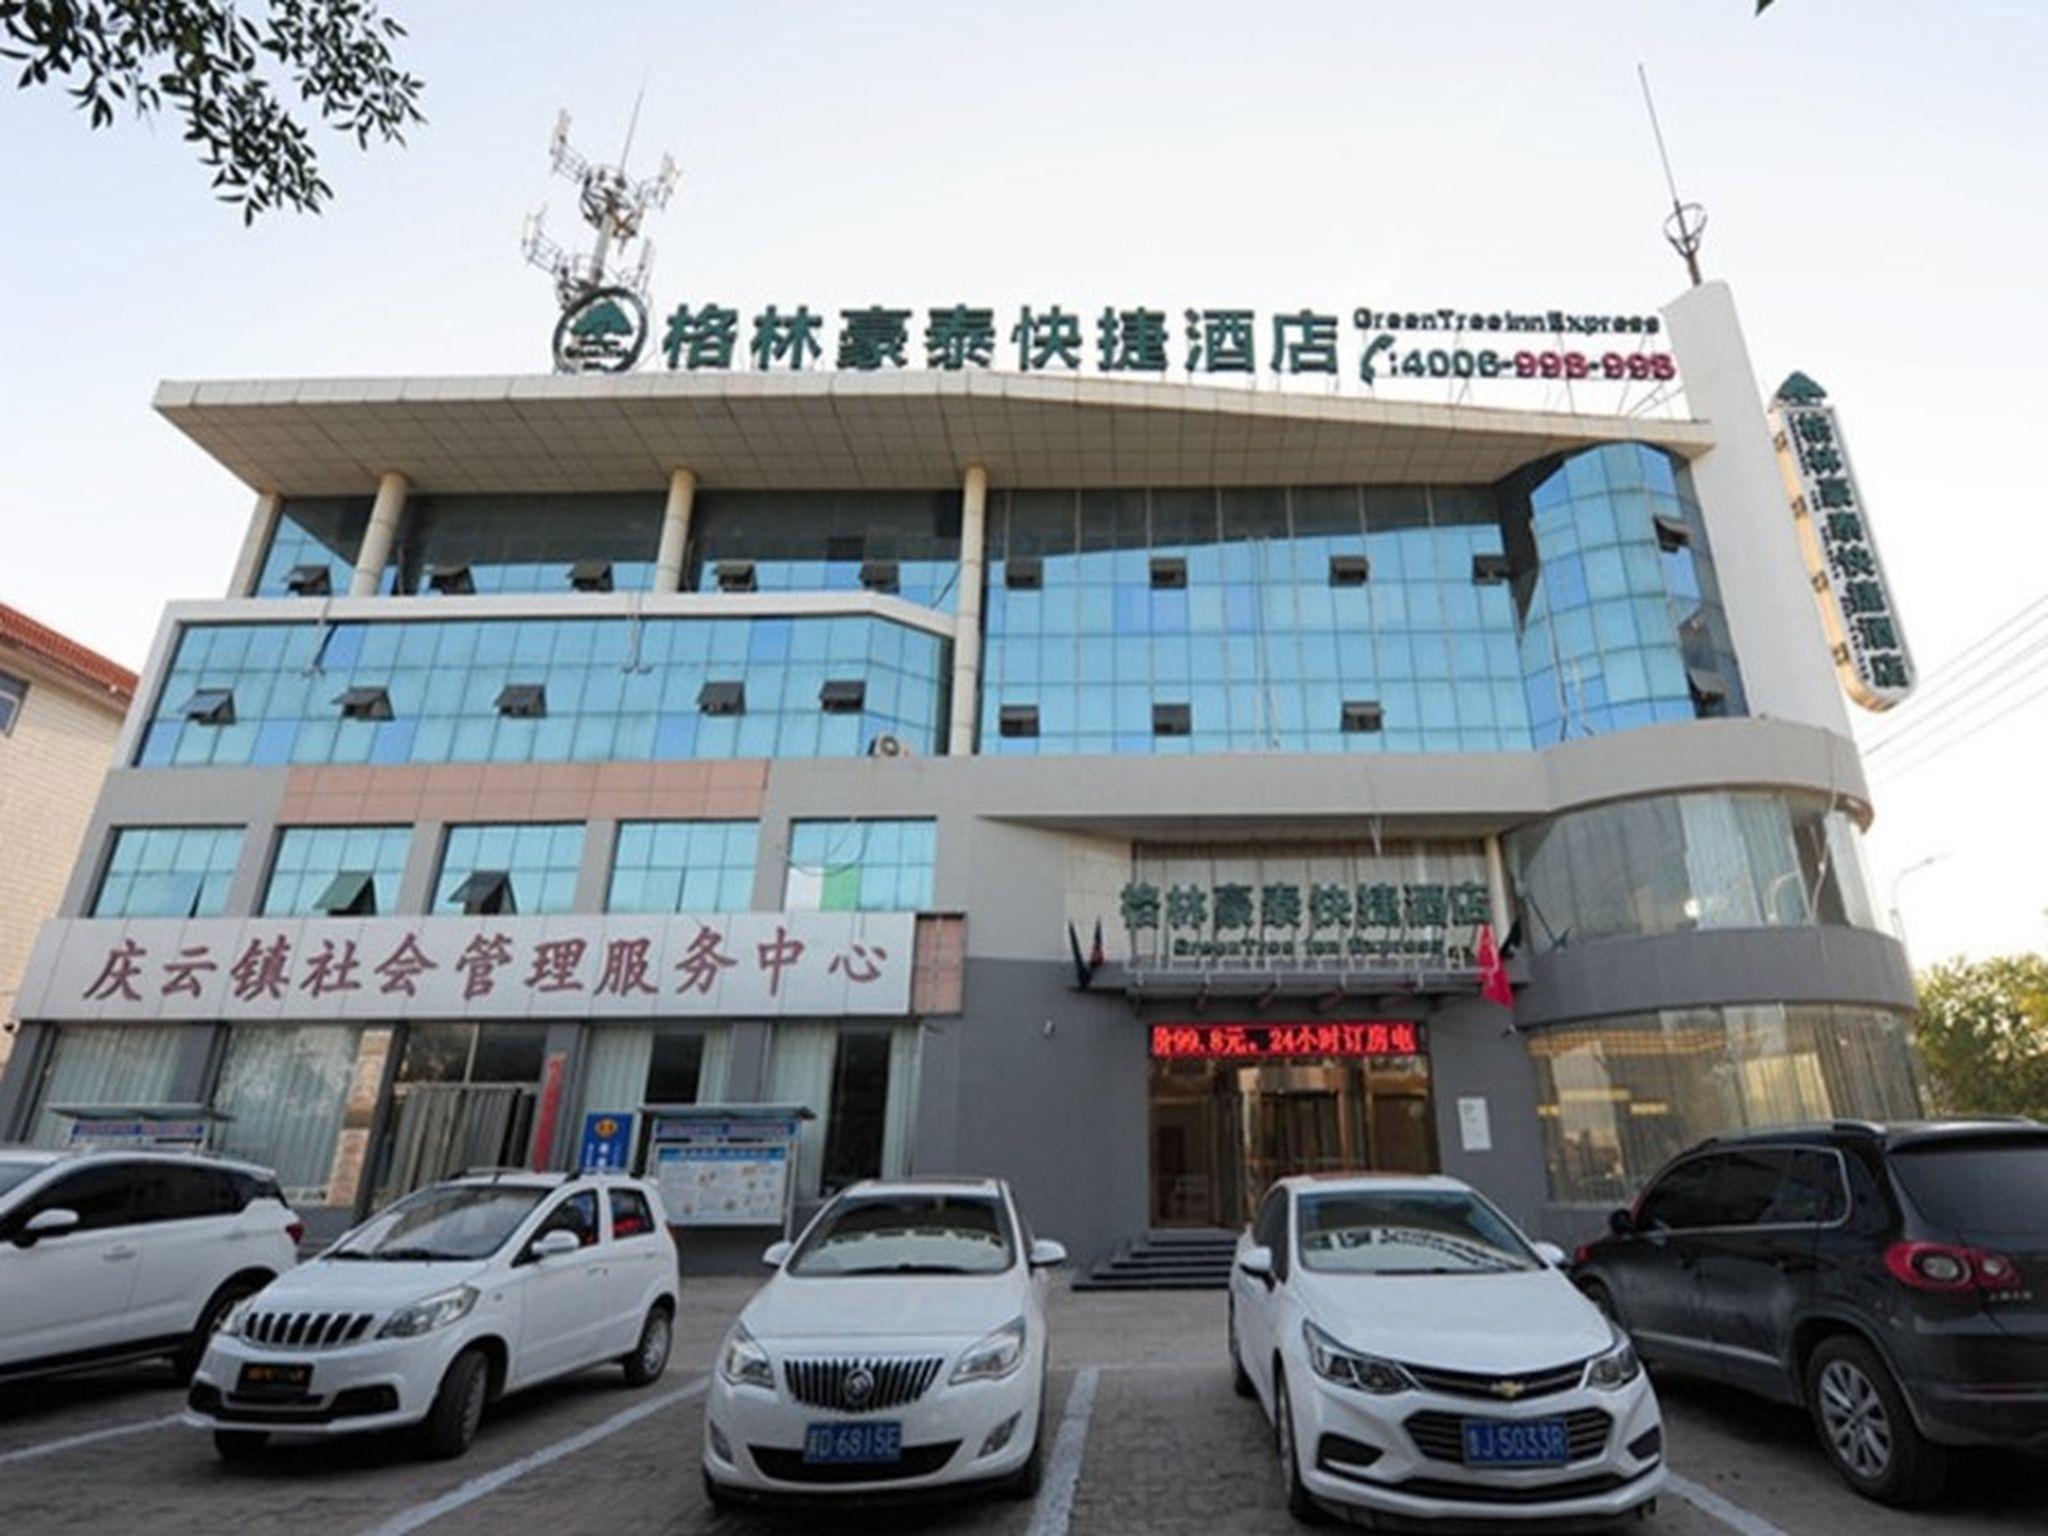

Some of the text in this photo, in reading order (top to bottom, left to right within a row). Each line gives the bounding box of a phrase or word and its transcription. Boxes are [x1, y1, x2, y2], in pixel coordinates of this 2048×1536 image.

[662, 303, 1339, 373] 格林豪泰快捷酒店
[1121, 882, 1492, 928] 格林豪泰快捷酒店
[83, 926, 888, 1001] 庆云镇社会管理服务中心
